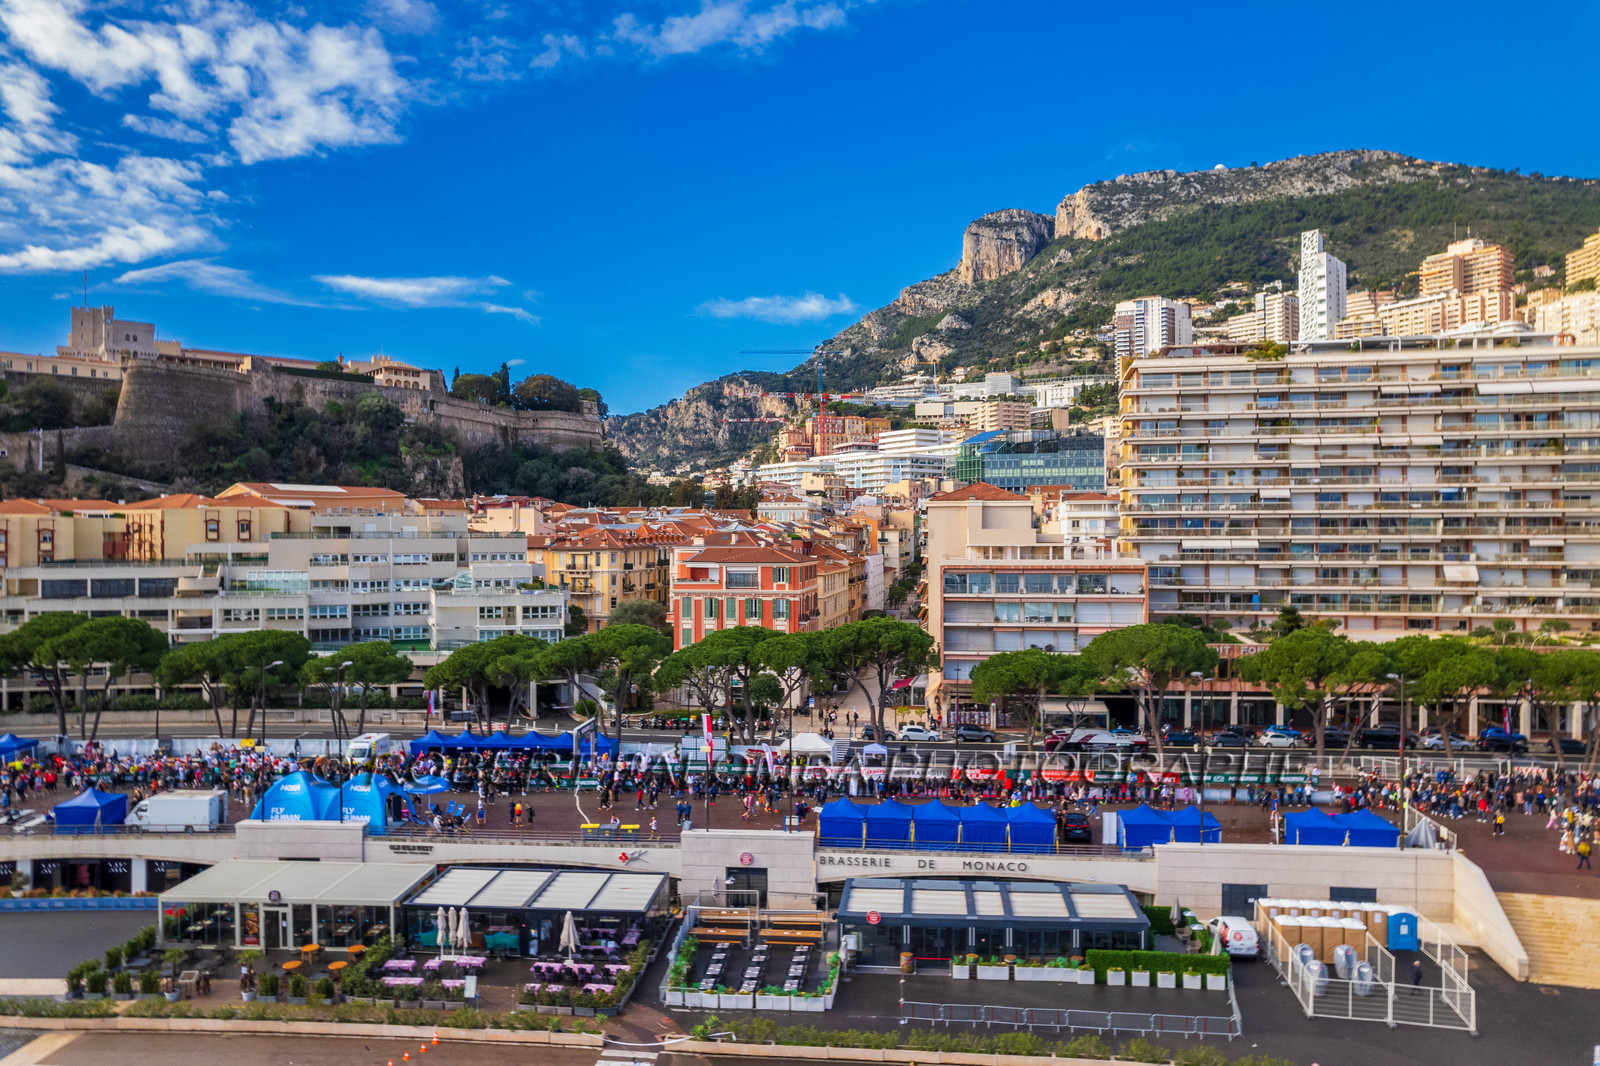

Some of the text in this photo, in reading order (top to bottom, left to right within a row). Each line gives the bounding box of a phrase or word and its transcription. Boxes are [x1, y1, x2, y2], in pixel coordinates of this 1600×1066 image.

[271, 807, 285, 815] FLY
[819, 856, 1028, 872] BRASSERIE DE MONACO
